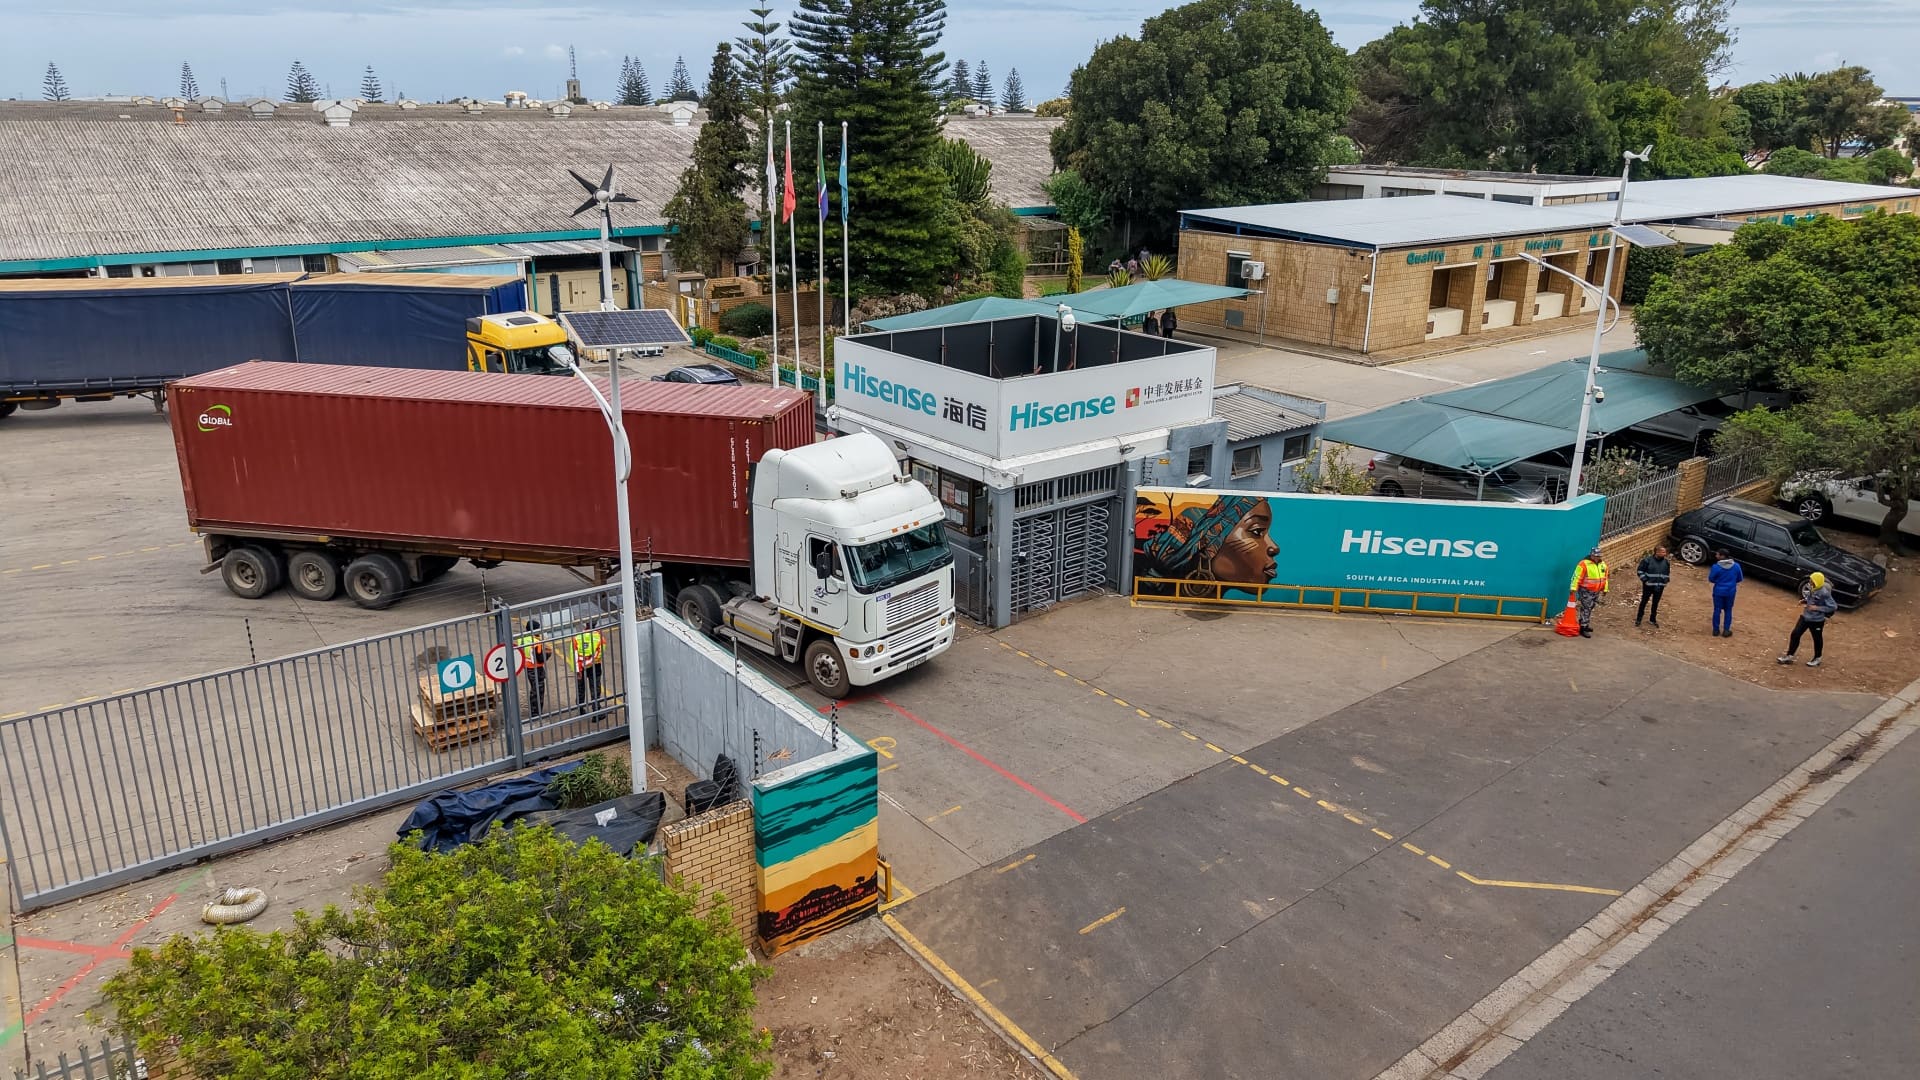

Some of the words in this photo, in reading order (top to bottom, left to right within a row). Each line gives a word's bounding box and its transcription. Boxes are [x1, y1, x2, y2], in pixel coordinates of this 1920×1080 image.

[1407, 250, 1445, 264] Quality
[844, 362, 937, 416] Hisense
[1144, 376, 1203, 399] 中非发展基金
[199, 414, 233, 426] GLOBAL
[943, 396, 987, 431] 海信
[1009, 395, 1116, 432] Hisense
[1341, 529, 1499, 559] Hisense
[1346, 574, 1375, 582] SOUTH
[1377, 575, 1408, 583] AFRICA
[1411, 576, 1461, 585] INDUSTRIAL
[450, 664, 462, 684] 1
